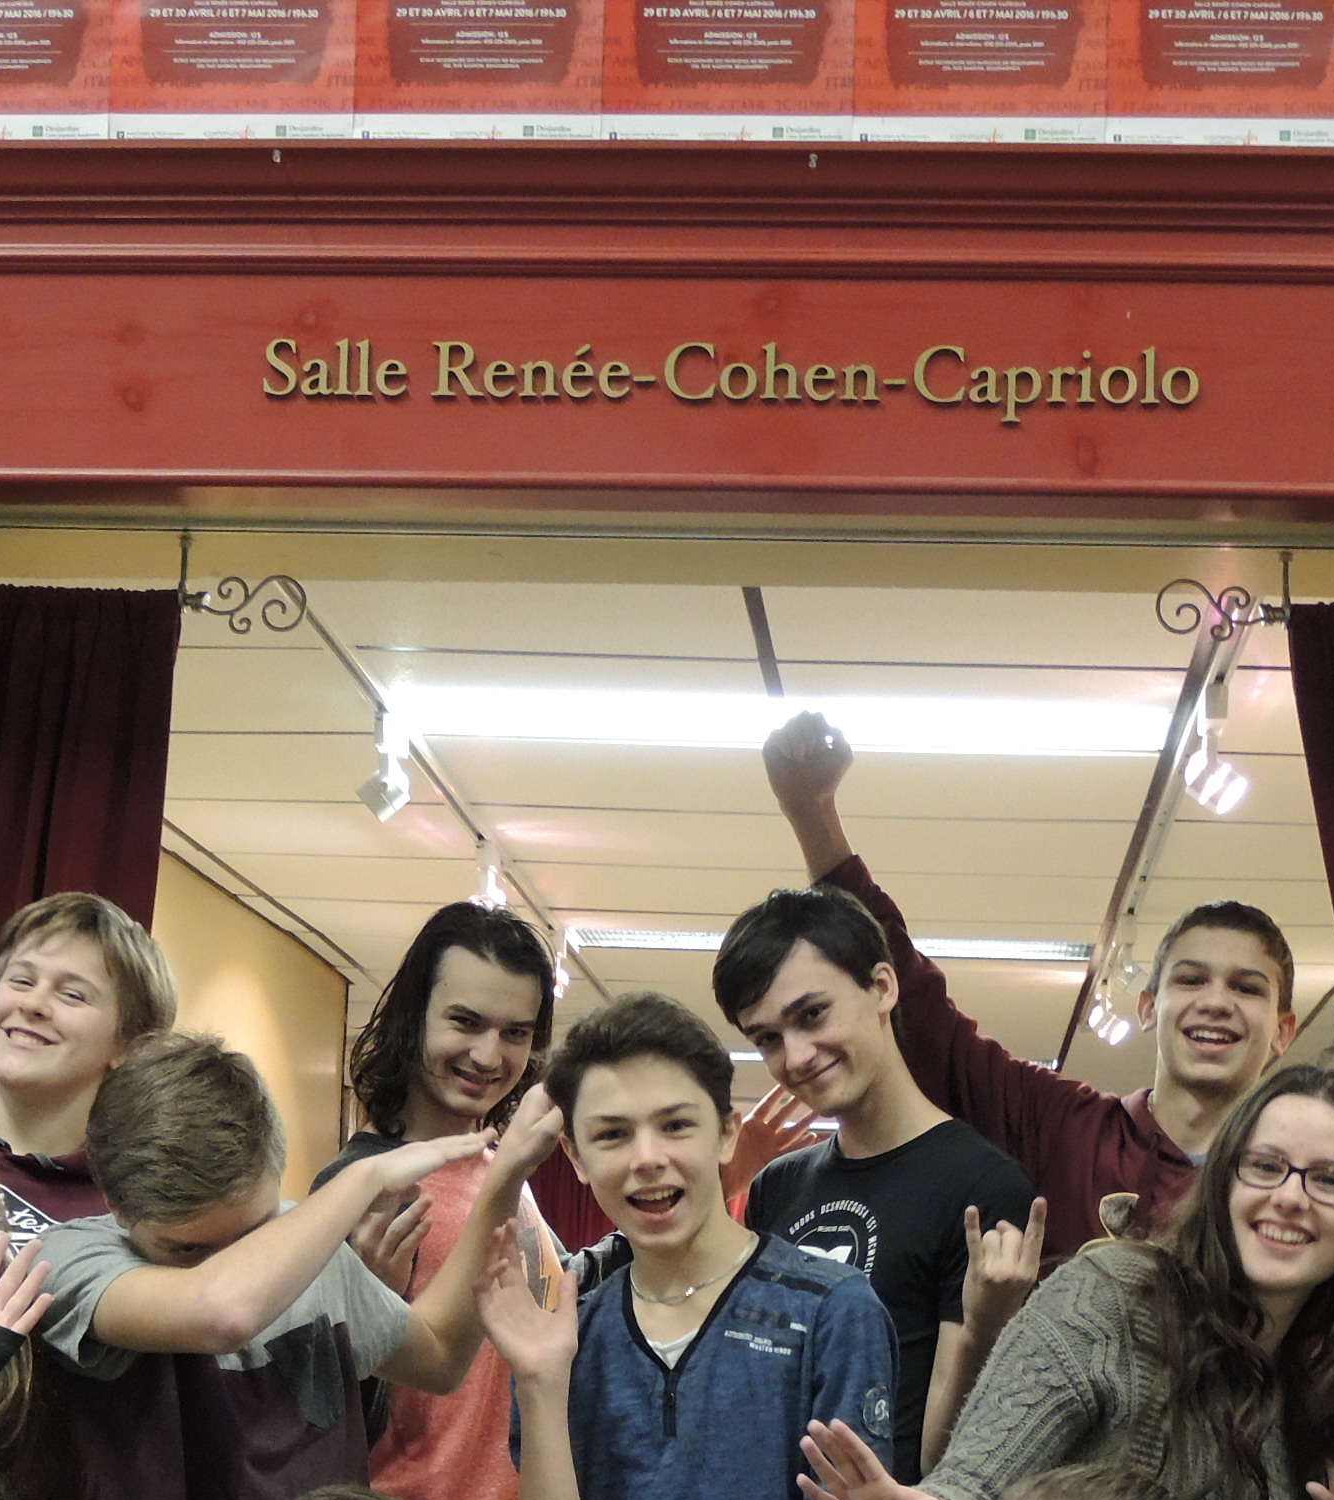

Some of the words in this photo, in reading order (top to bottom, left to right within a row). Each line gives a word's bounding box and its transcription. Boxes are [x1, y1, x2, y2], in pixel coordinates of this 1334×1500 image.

[1148, 10, 1159, 19] 29
[1161, 10, 1173, 19] ET
[1174, 10, 1186, 19] 30
[1188, 10, 1216, 20] AVRIL
[1230, 11, 1242, 20] ET
[1250, 11, 1268, 20] MAI
[262, 337, 409, 398] Salle
[430, 340, 1201, 426] Renée-Cohen-Capriolo
